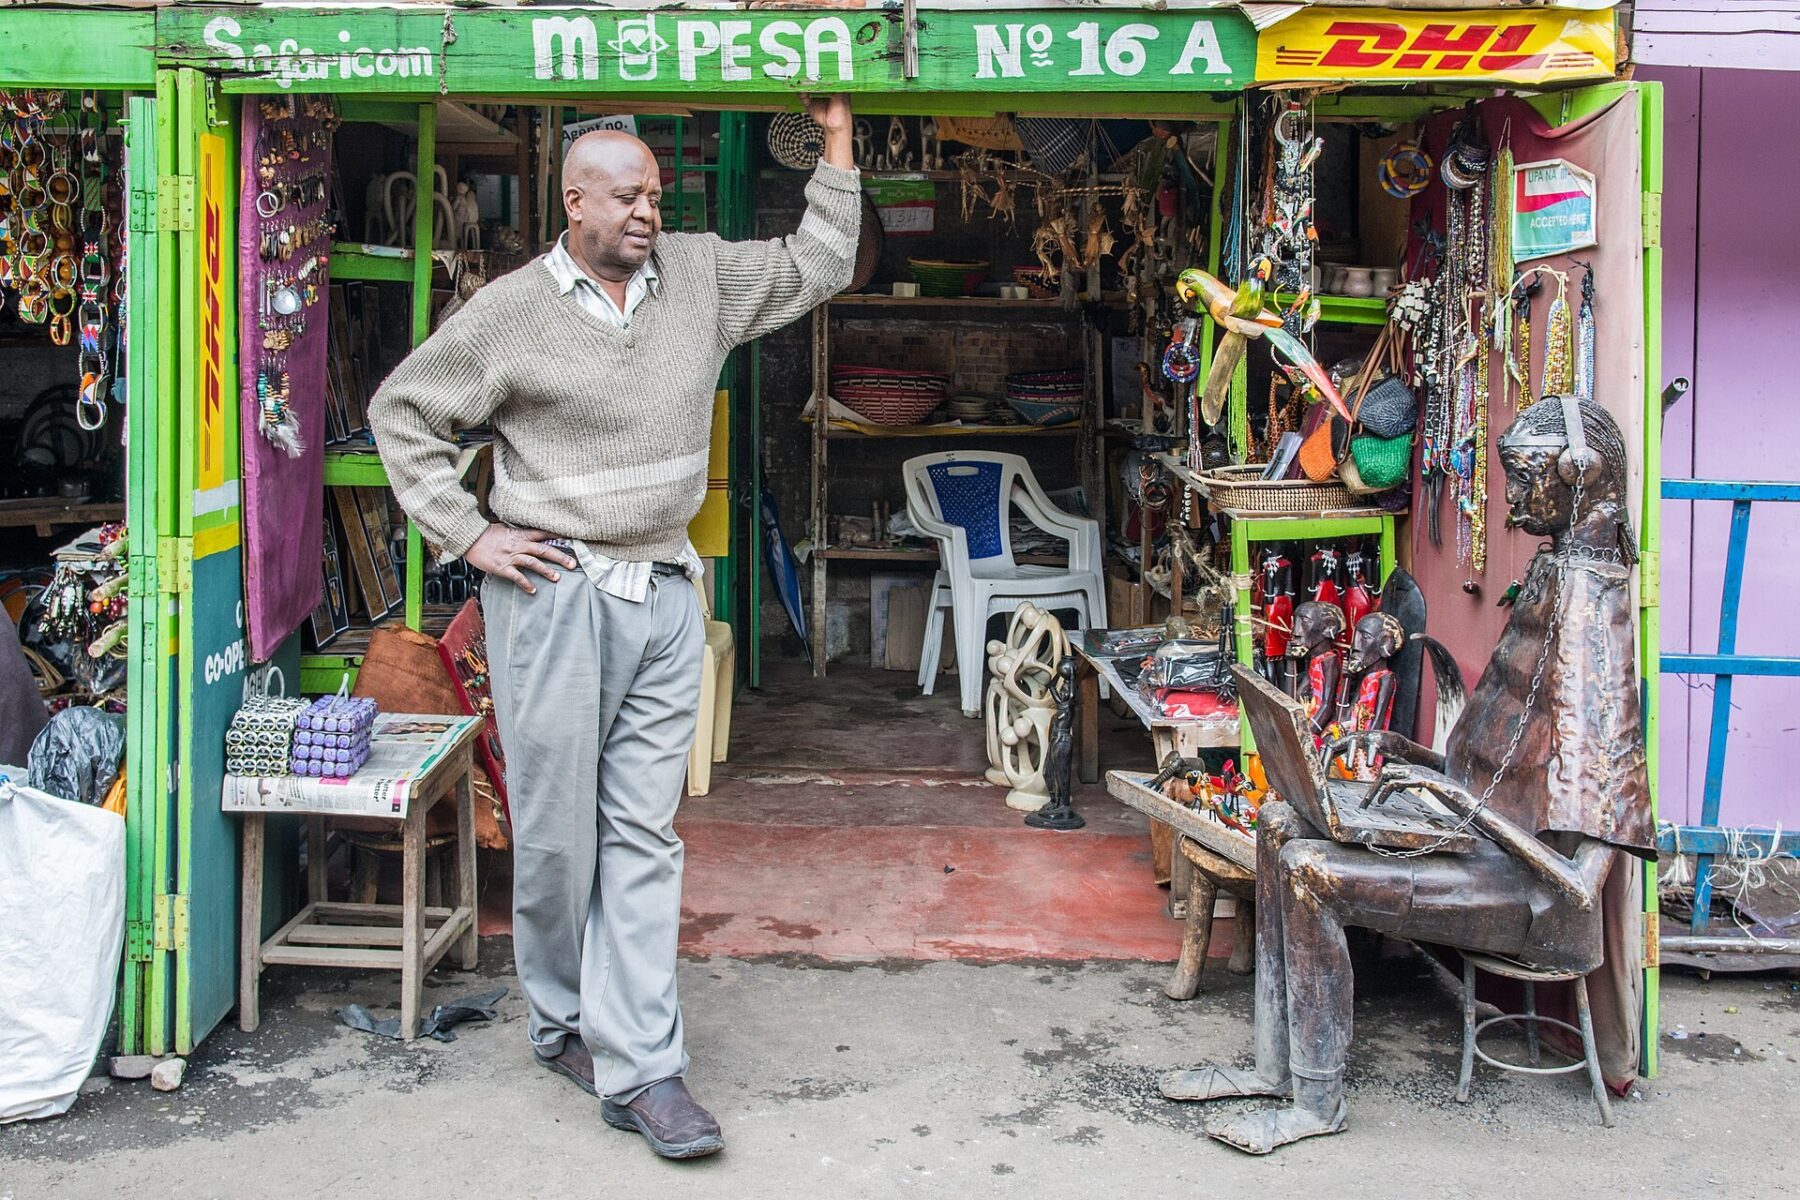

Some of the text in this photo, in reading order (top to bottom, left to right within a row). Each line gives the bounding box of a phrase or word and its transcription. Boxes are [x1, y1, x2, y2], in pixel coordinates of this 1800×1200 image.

[203, 16, 433, 88] Safaricom
[1066, 21, 1160, 77] 16
[1168, 20, 1233, 75] A
[1316, 21, 1549, 71] DHL
[605, 119, 628, 132] no.
[1528, 169, 1544, 183] LIPA
[1545, 168, 1557, 180] NA
[1530, 213, 1588, 229] ACCEPTED HERE
[204, 196, 220, 430] DHL
